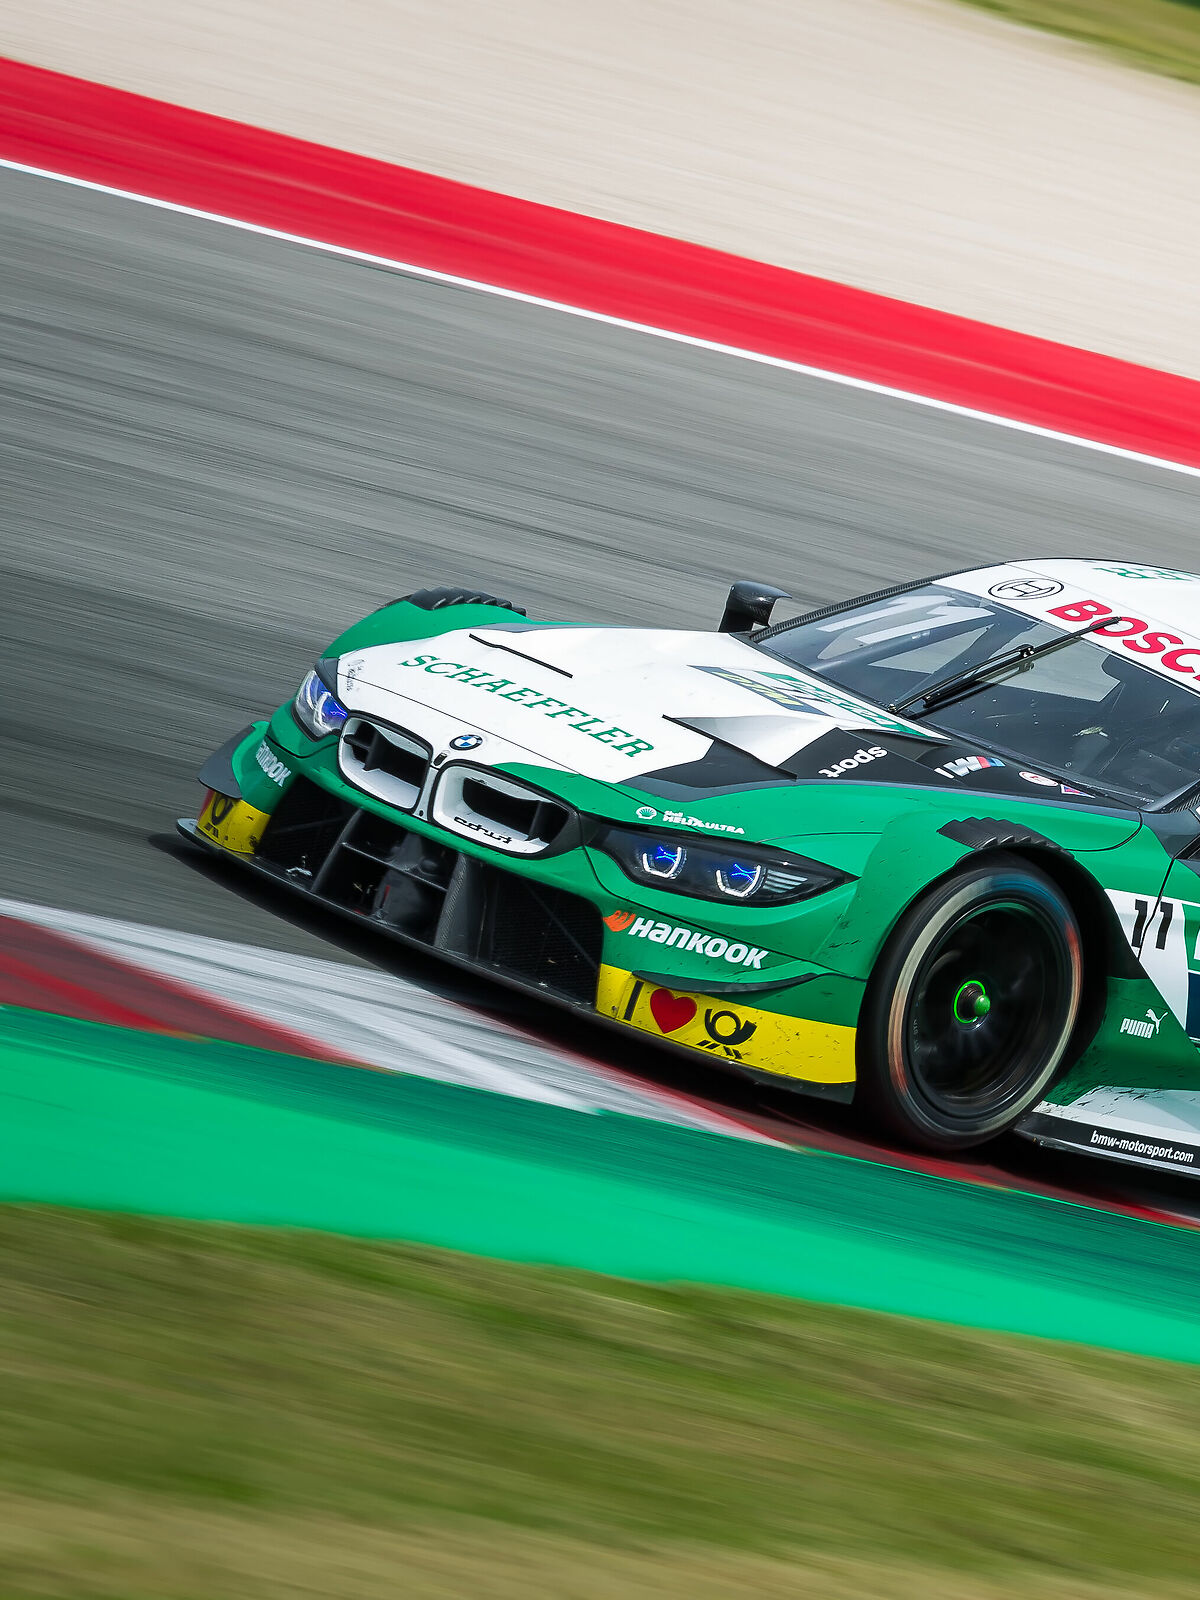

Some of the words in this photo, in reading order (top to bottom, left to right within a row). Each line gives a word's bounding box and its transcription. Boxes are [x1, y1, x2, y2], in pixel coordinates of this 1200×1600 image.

[401, 654, 654, 759] SCHAEFFLER
[818, 745, 889, 779] sport
[704, 822, 745, 835] ULTRA
[1131, 898, 1173, 952] 11
[1120, 1015, 1156, 1039] PUMA
[1090, 1130, 1195, 1164] bmw-motorsport.com
